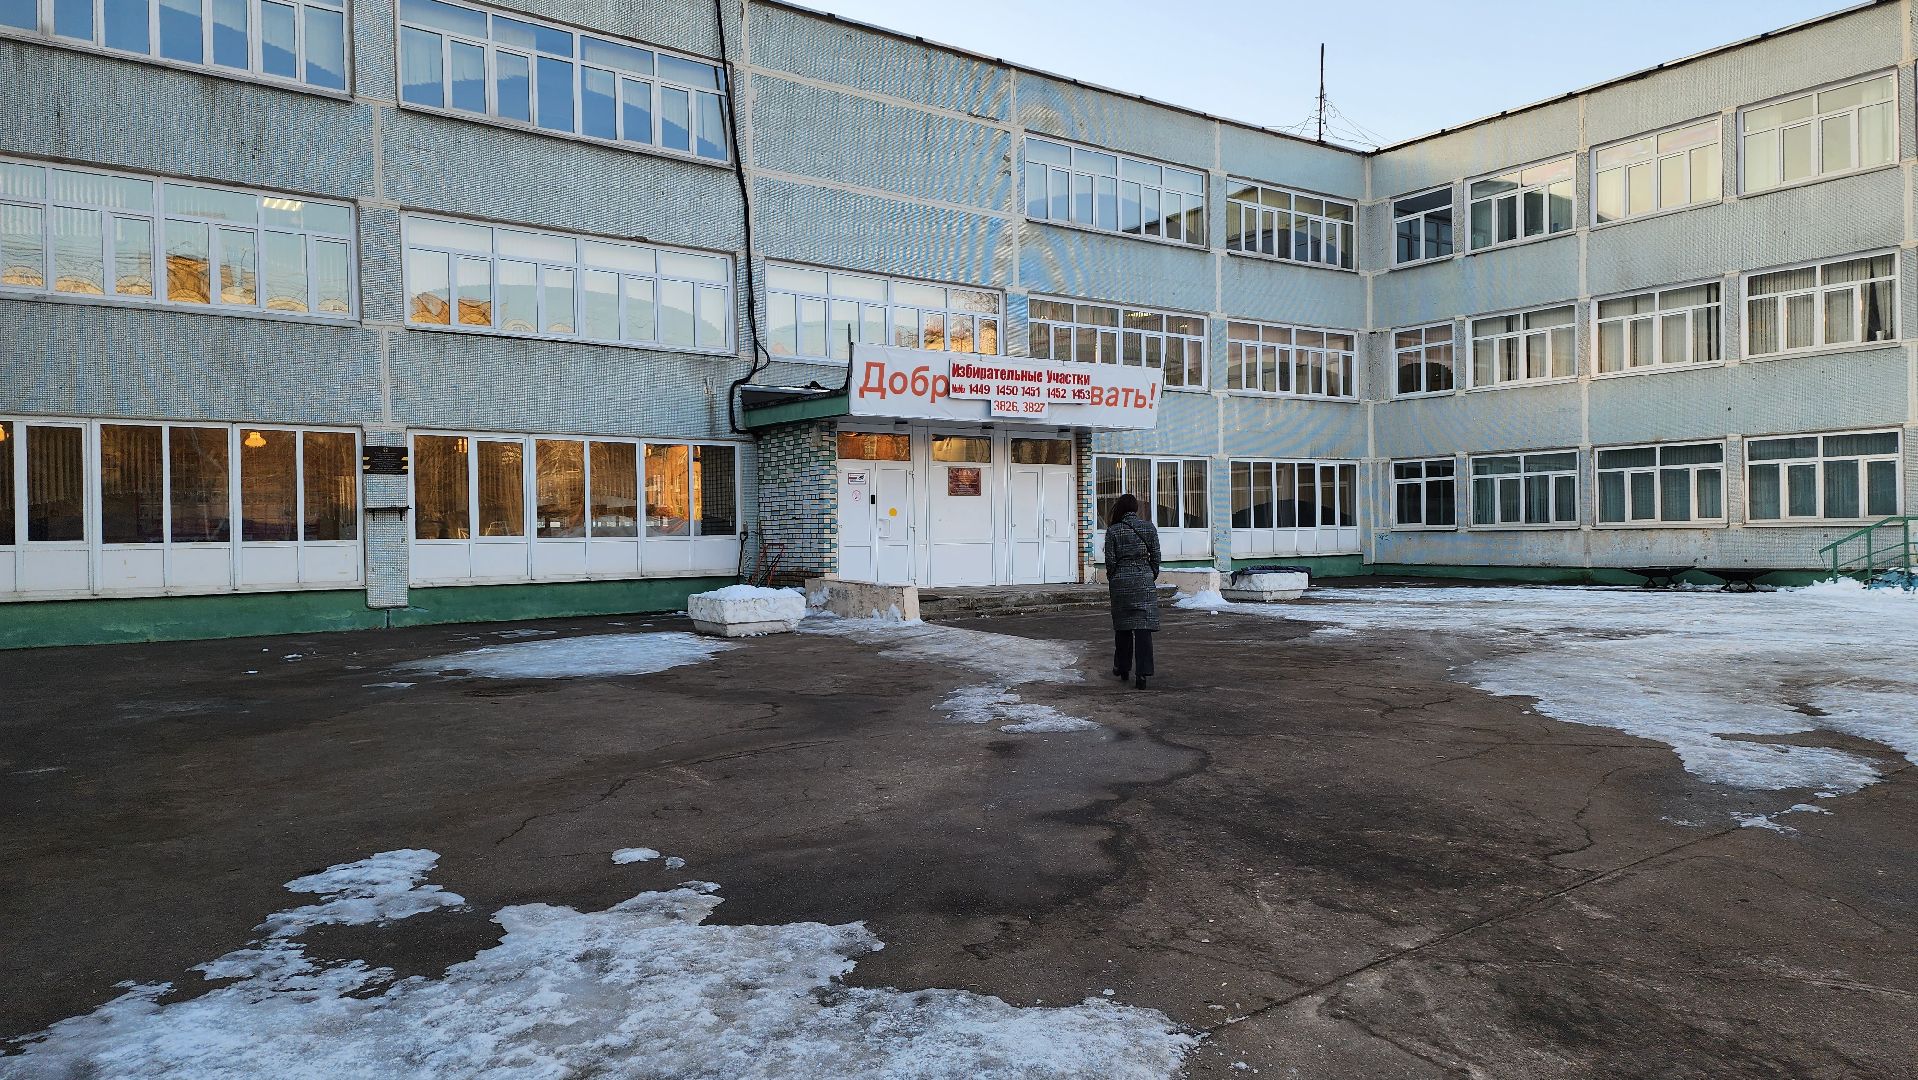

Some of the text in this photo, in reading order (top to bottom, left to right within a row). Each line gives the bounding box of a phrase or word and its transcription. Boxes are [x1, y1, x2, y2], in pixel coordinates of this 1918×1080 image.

[952, 362, 1091, 386] Избирательные Участки
[858, 361, 1156, 410] Добр вать!
[968, 383, 991, 395] 1449
[996, 384, 1018, 396] 1450
[1021, 386, 1040, 398] 1451
[1046, 387, 1067, 399] 1452
[1071, 389, 1091, 400] 1453
[993, 400, 1046, 413] 3826, 3827
